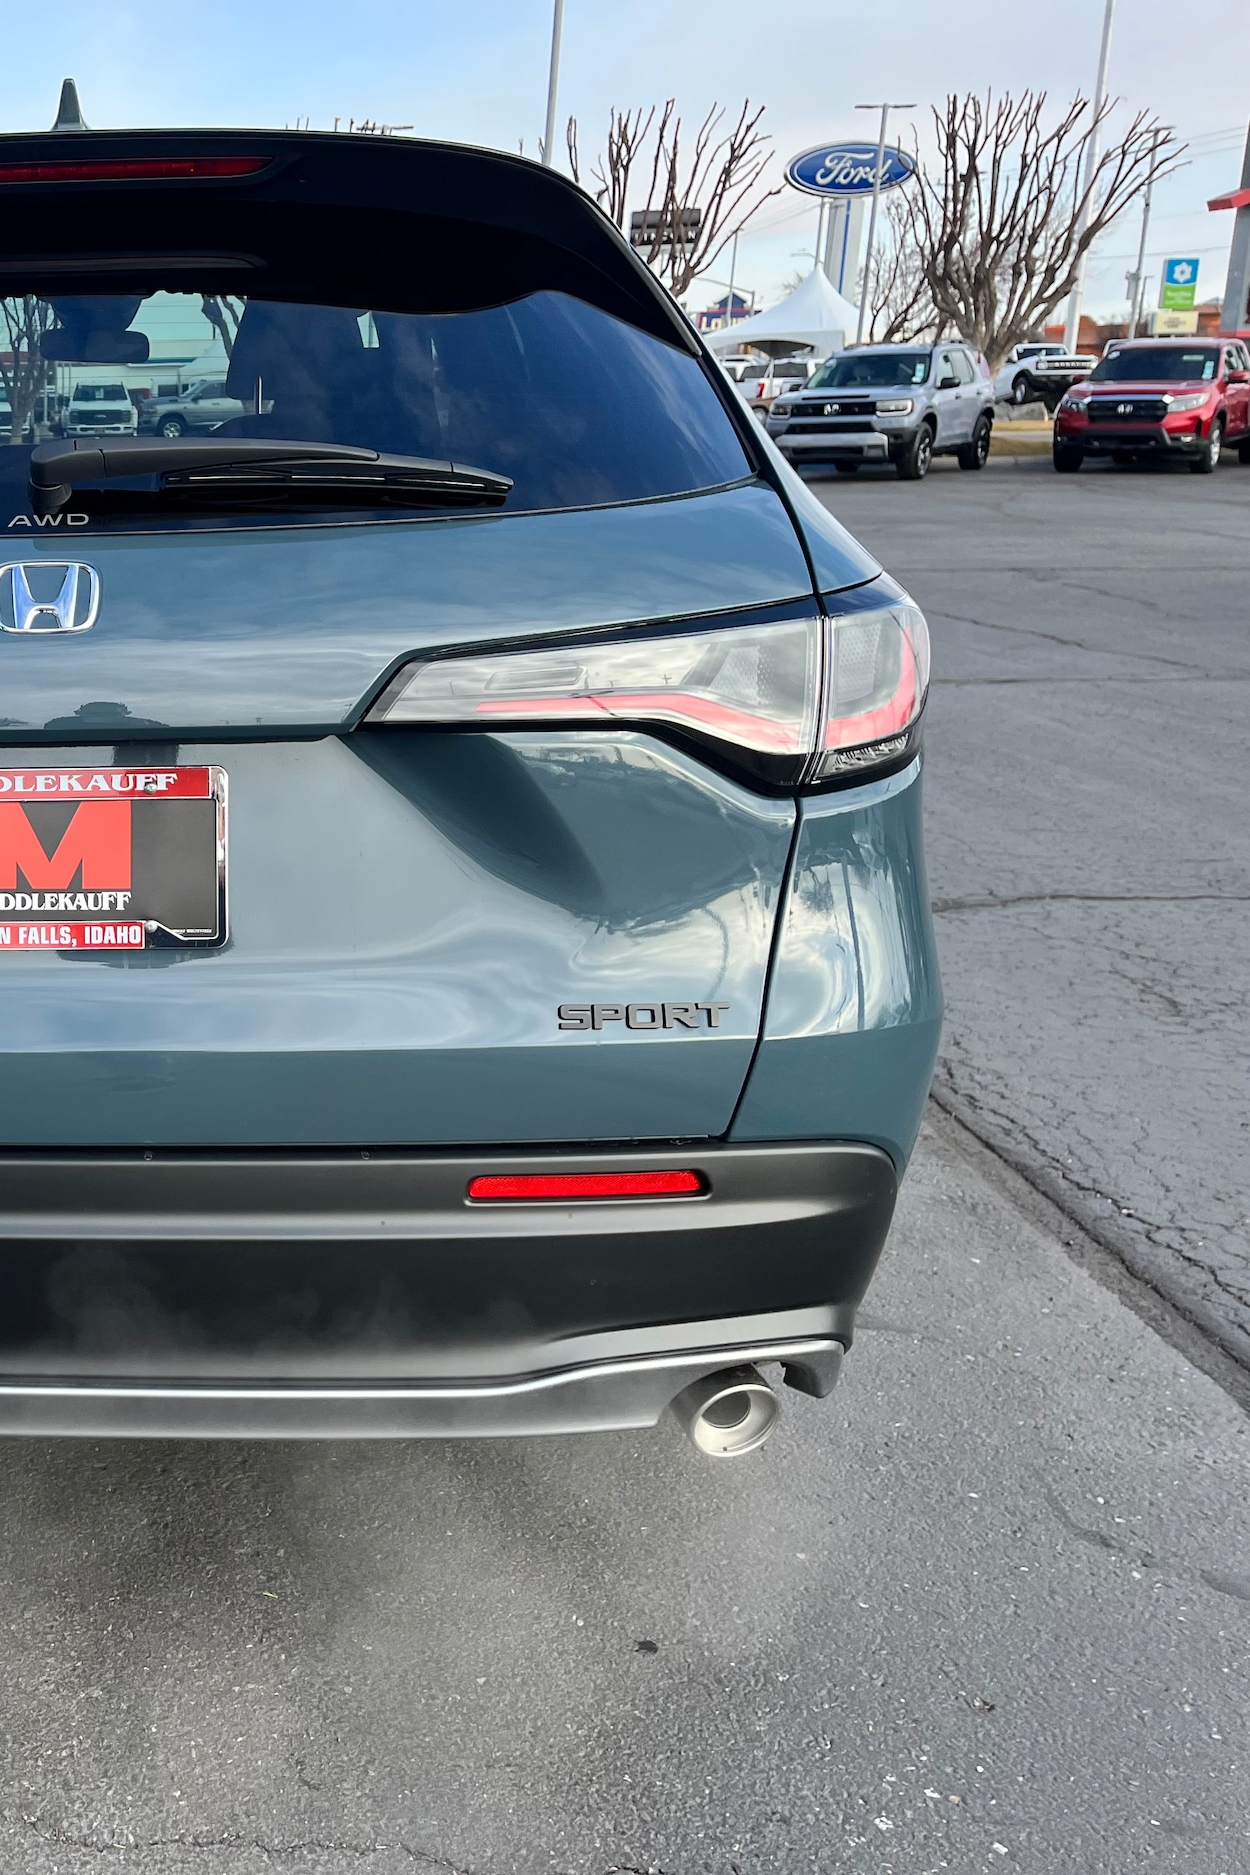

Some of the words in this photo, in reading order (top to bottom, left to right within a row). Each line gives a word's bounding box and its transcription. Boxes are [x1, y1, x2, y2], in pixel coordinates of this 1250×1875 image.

[815, 152, 892, 185] Ford
[8, 513, 90, 528] AWD
[19, 926, 78, 949] FALLS,
[85, 924, 142, 945] IDAHO
[557, 1002, 731, 1030] SPORT
